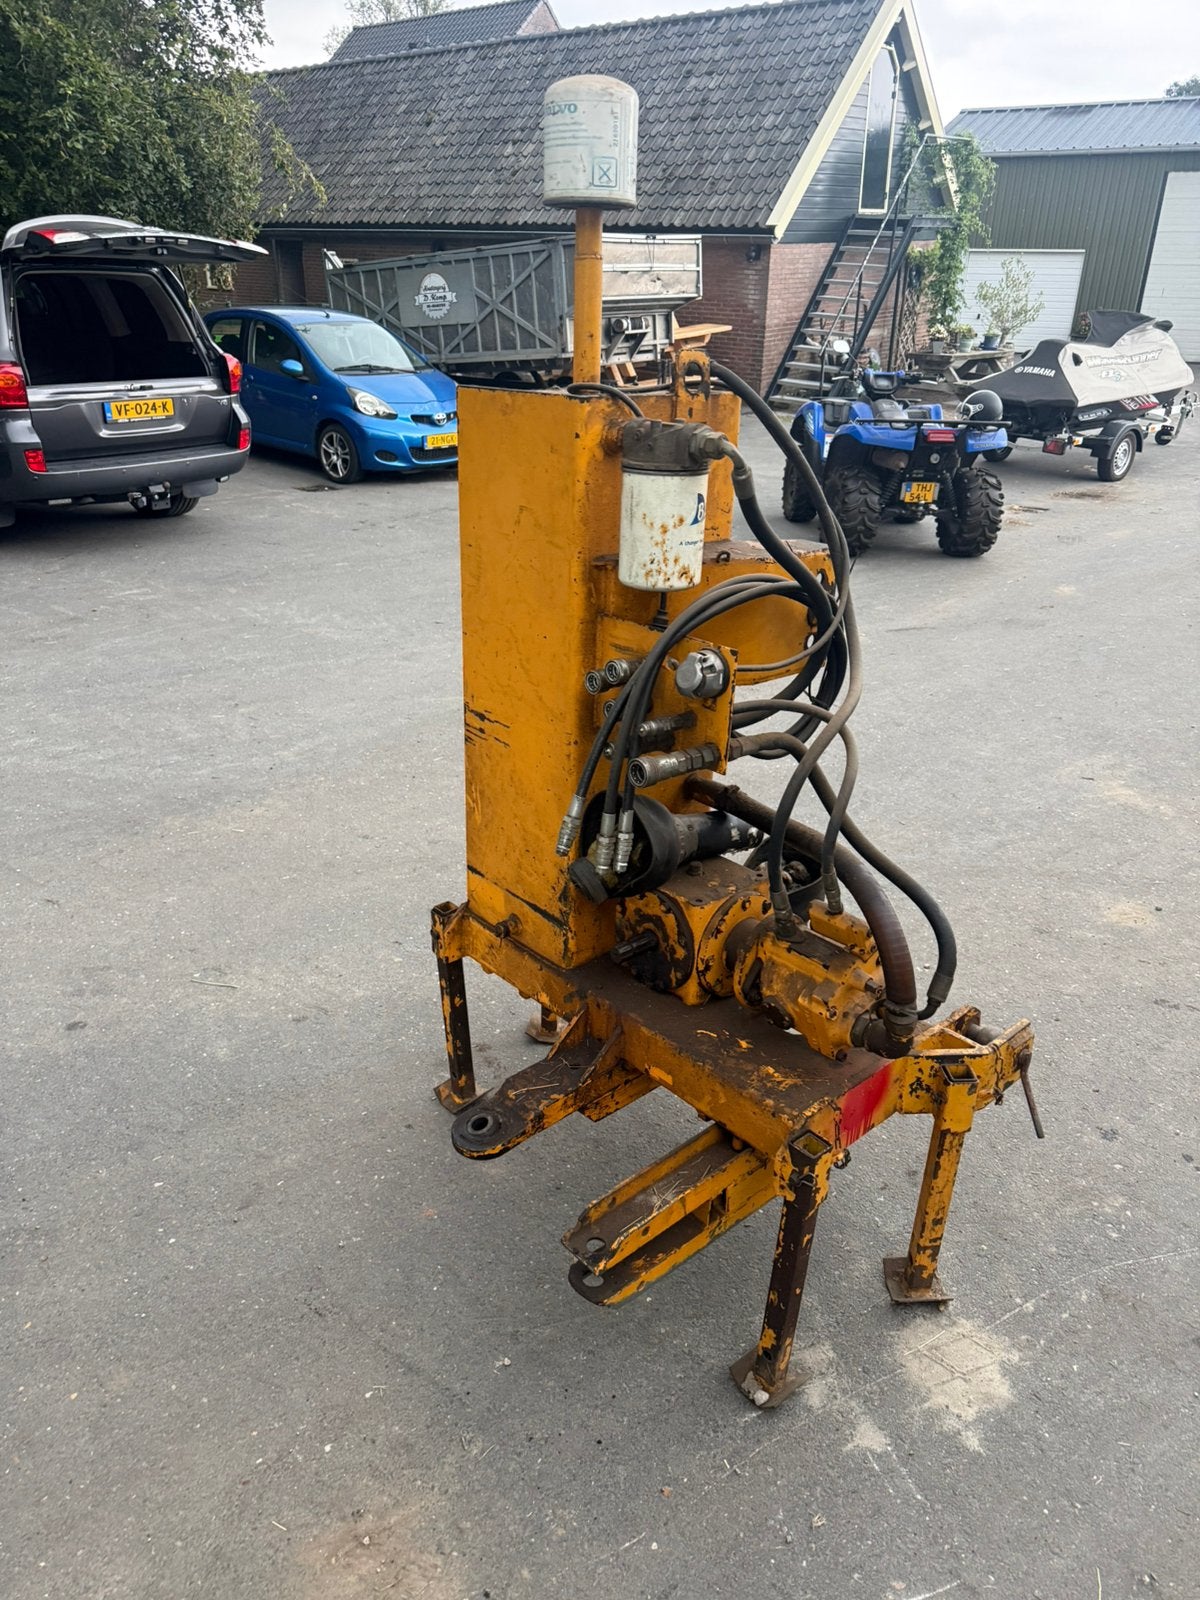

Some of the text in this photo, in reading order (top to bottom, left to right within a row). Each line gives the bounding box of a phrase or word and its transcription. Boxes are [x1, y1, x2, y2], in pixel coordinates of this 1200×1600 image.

[1022, 365, 1056, 378] YAMAHA
[115, 401, 170, 416] VF-024-K
[916, 483, 933, 492] THJ
[909, 492, 929, 501] 54-L
